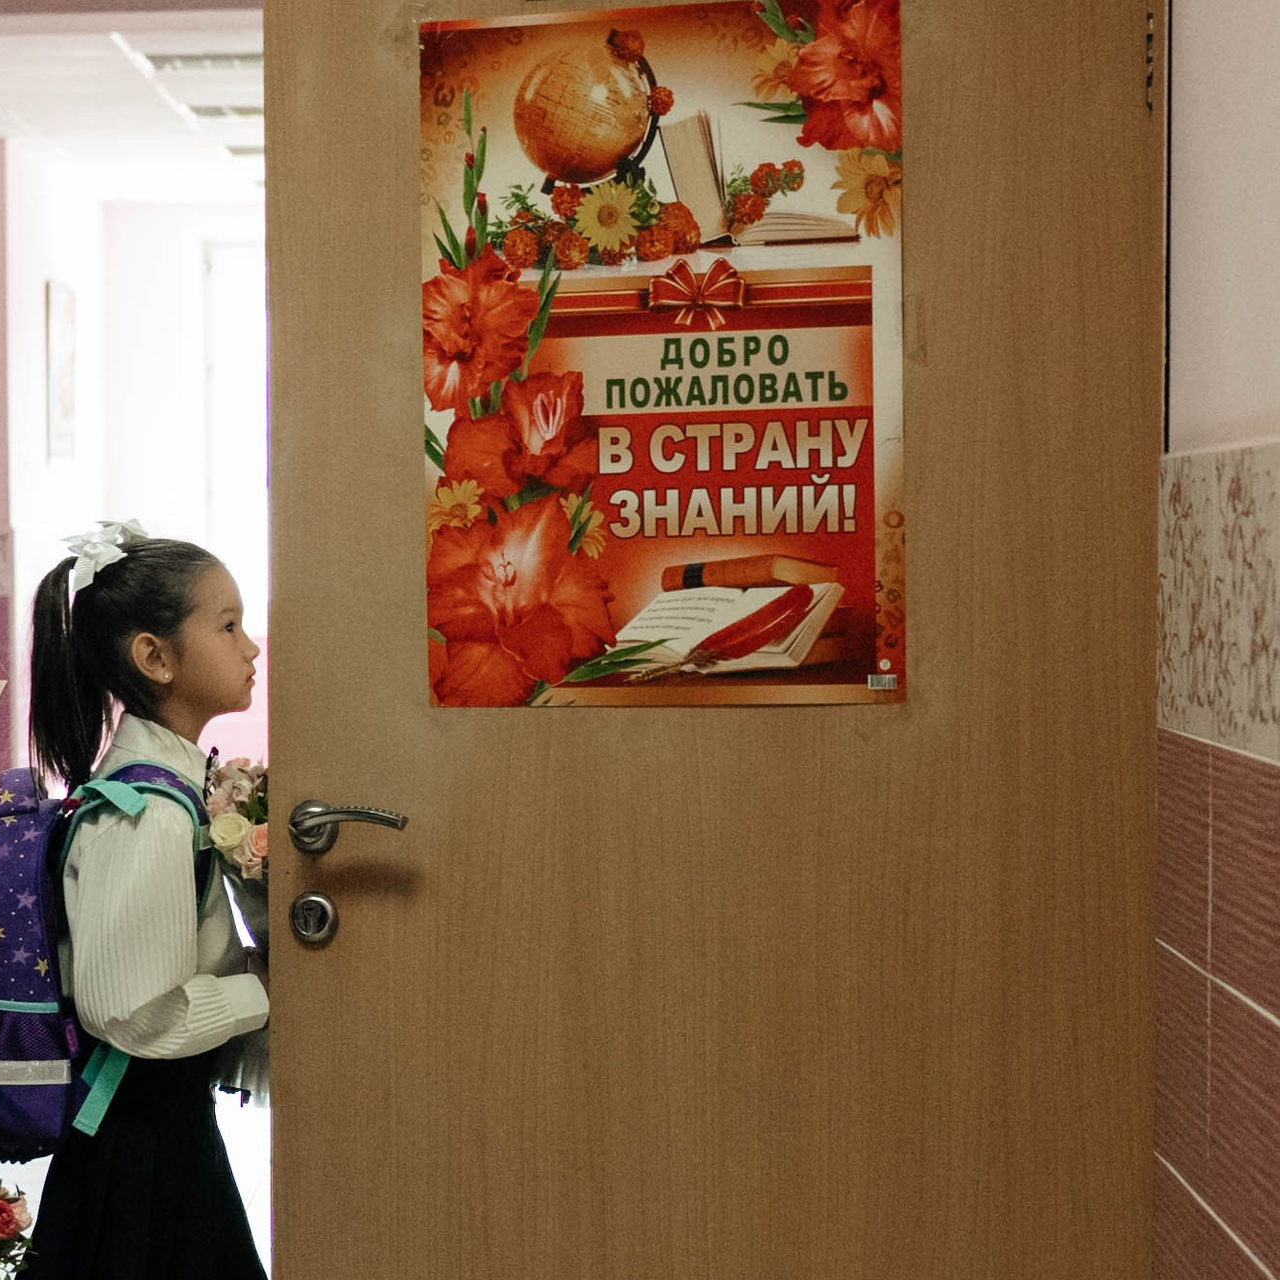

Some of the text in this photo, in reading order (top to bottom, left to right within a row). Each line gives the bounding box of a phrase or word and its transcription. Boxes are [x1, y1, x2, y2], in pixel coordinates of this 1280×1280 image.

[660, 334, 790, 370] ДОБРО
[605, 370, 849, 409] ПОЖАЛОВАТЬ
[598, 418, 869, 475] В СТРАНУ
[608, 472, 857, 538] ЗНАНИЙ!
